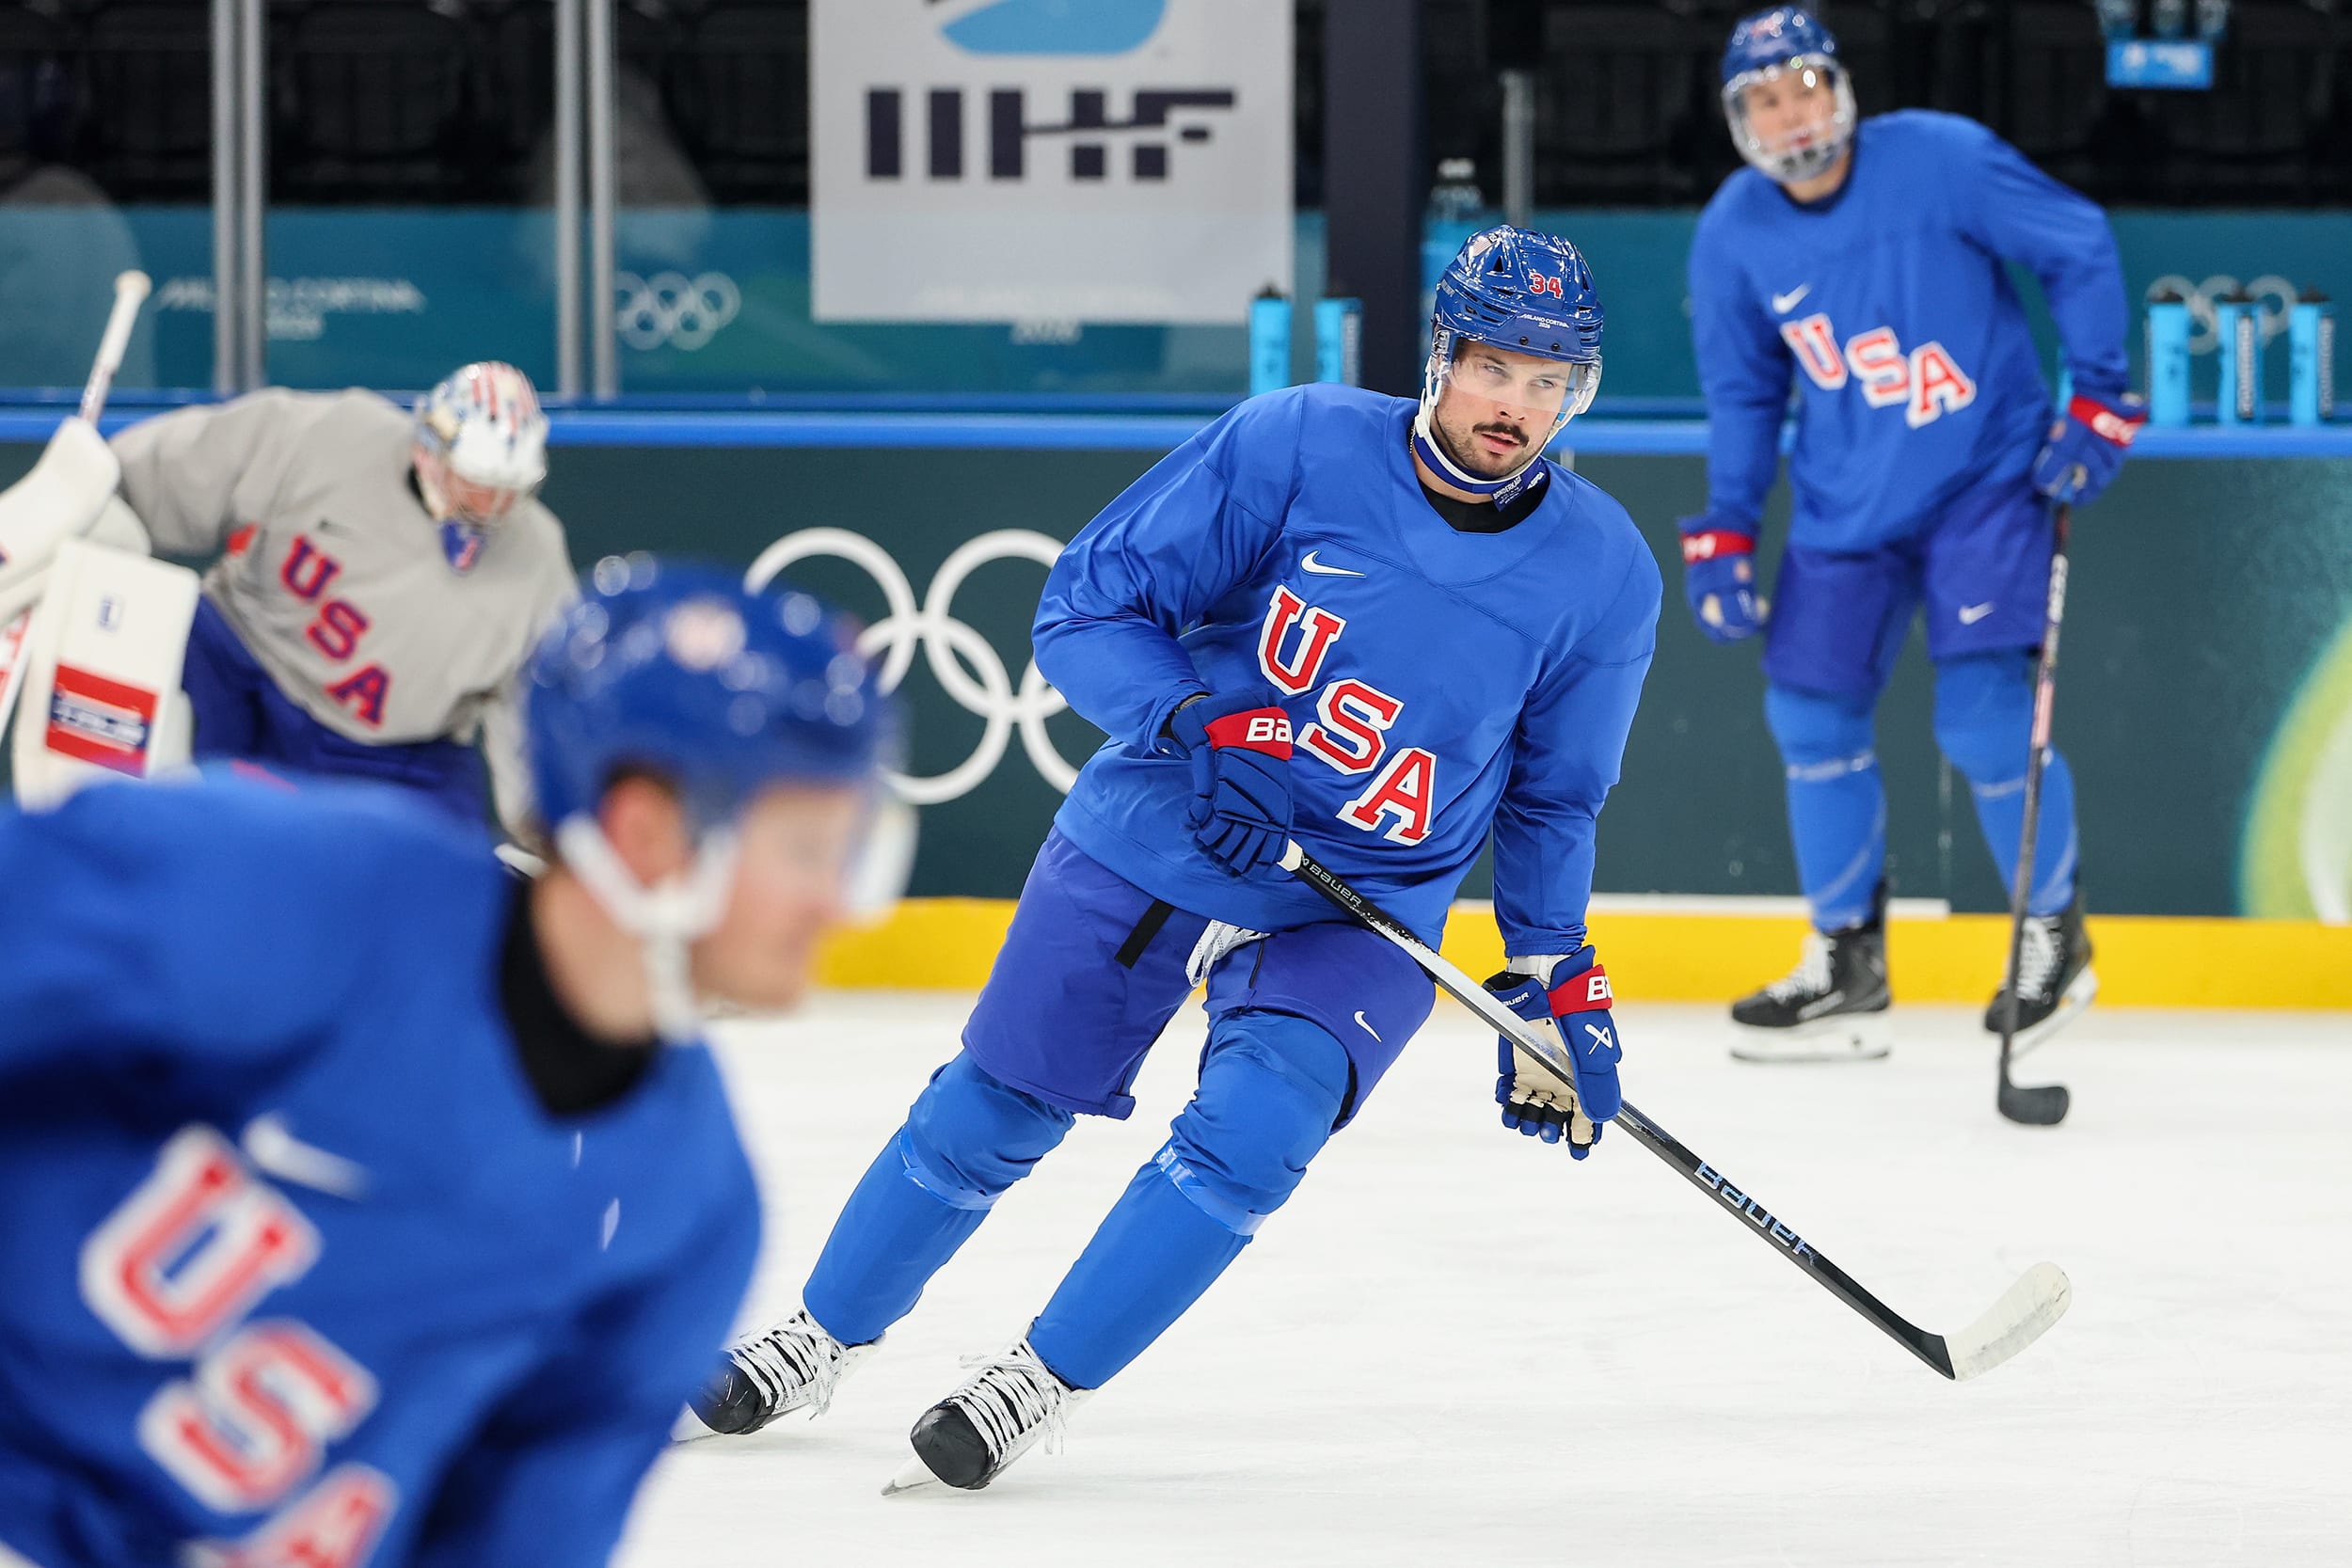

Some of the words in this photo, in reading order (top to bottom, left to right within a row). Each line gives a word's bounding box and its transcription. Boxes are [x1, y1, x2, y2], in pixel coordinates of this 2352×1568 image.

[866, 87, 1235, 180] IIHF
[1529, 272, 1563, 299] 34
[1781, 312, 1976, 428] USA
[280, 533, 391, 729] USA
[1258, 584, 1437, 846] USA
